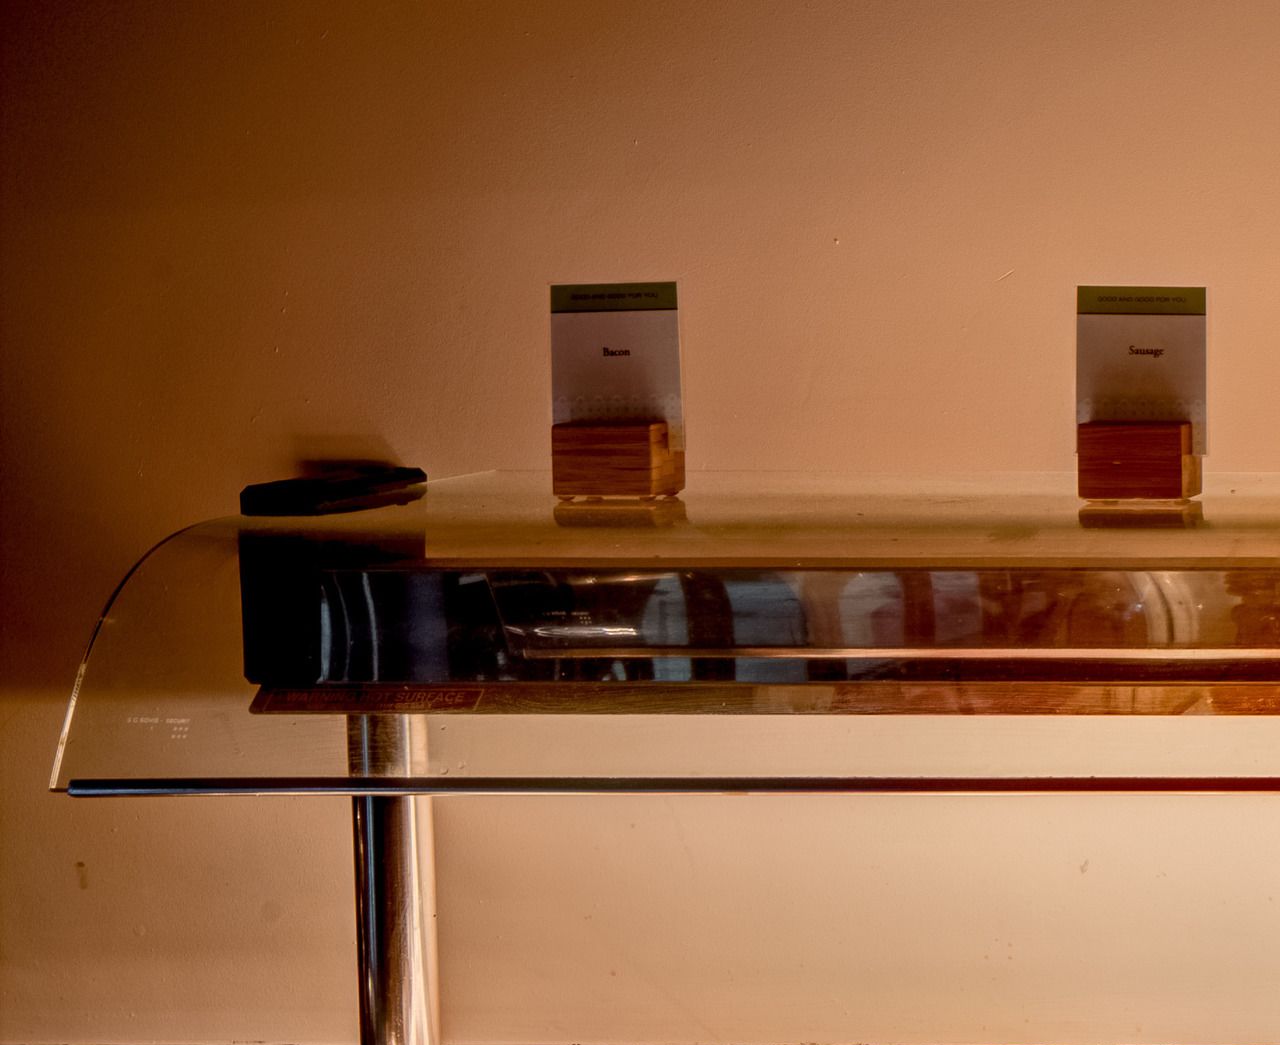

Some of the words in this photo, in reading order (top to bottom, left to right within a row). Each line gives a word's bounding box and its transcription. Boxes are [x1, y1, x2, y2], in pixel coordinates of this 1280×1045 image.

[603, 347, 630, 357] Bacon
[1128, 345, 1165, 358] Sausage
[394, 692, 466, 702] SURFACE
